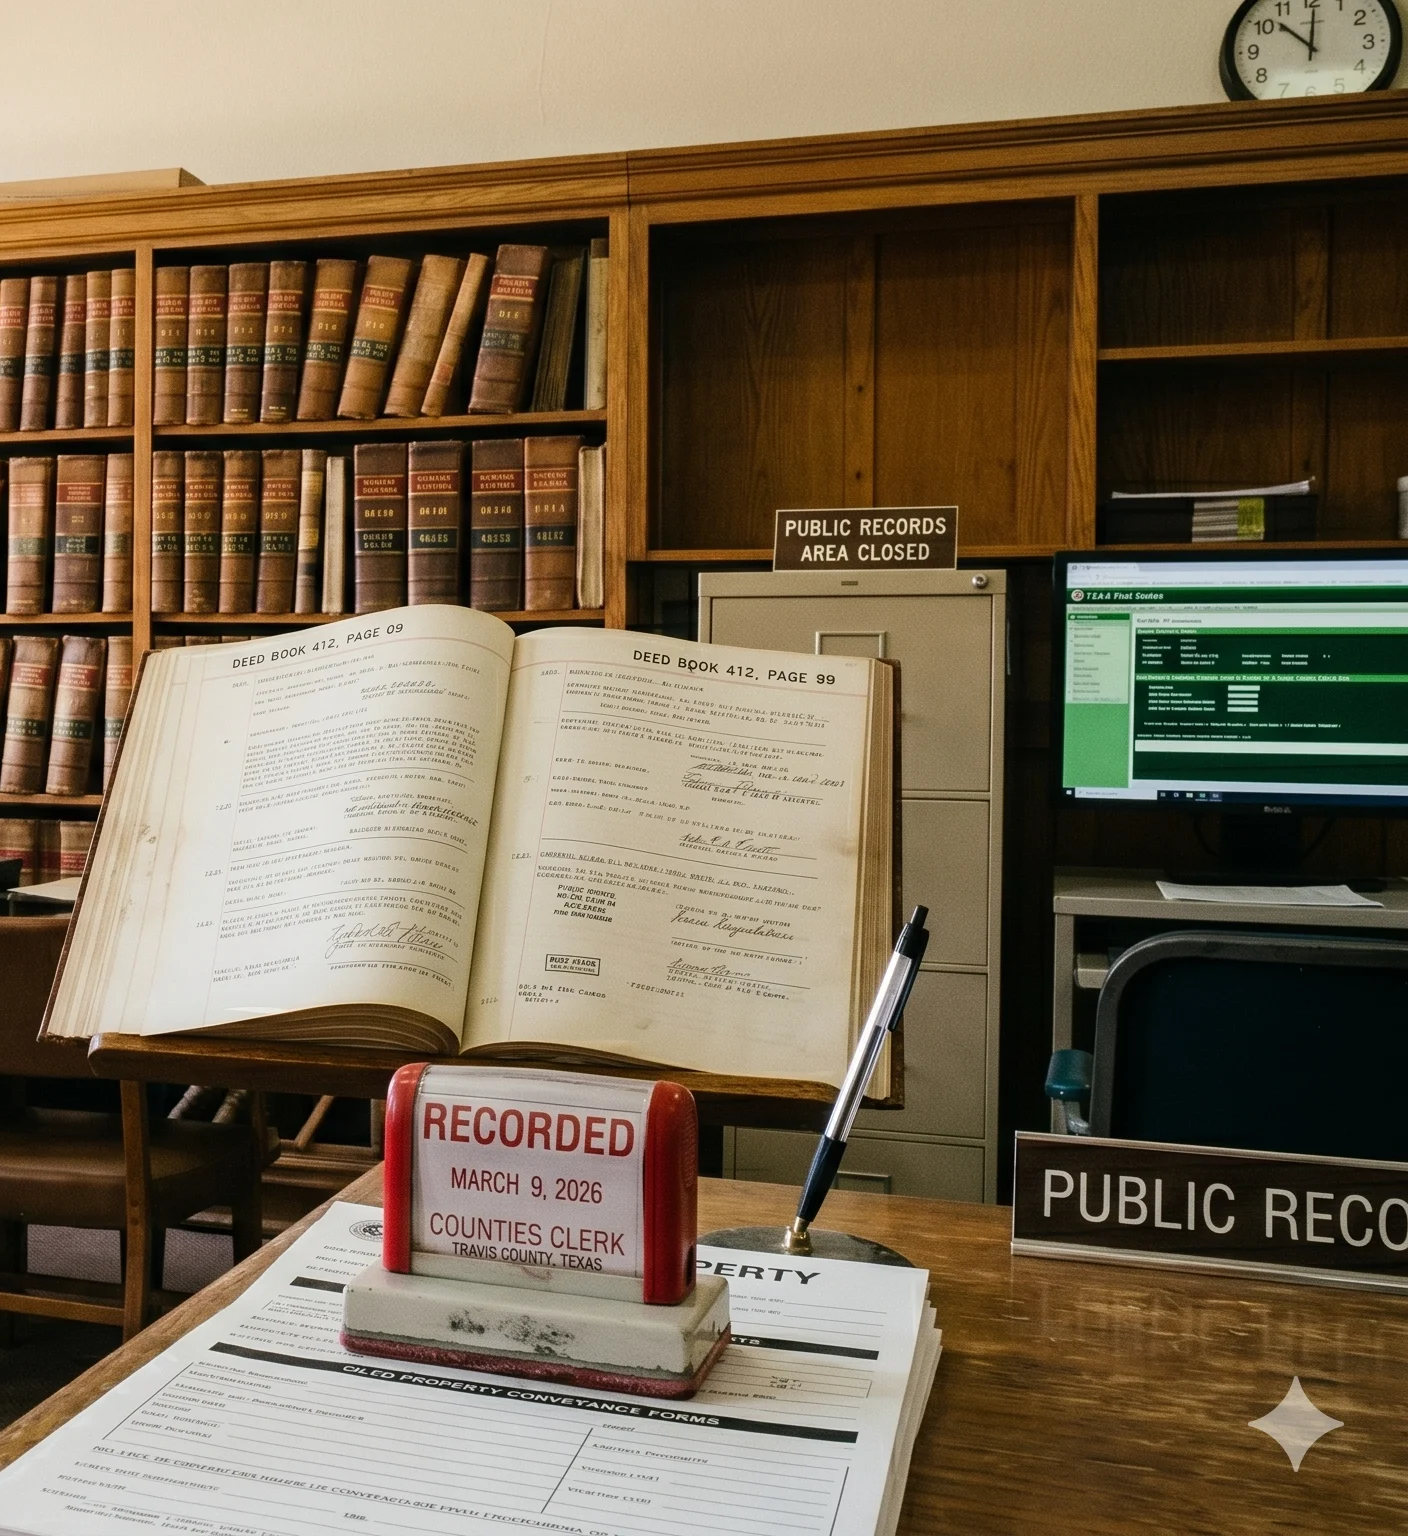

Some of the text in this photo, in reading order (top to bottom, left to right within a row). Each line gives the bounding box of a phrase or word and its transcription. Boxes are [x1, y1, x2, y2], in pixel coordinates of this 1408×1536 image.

[1275, 1, 1290, 16] 11
[1354, 10, 1366, 26] 2
[1254, 19, 1274, 35] 10
[1363, 34, 1375, 49] 3
[1248, 44, 1259, 60] 9
[1256, 68, 1267, 83] 8
[1354, 59, 1366, 74] 4
[1278, 83, 1289, 98] 7
[1334, 78, 1345, 93] 5
[785, 517, 947, 537] PUBLIC RECORDS
[800, 543, 930, 562] AREA CLOSED
[232, 623, 404, 668] DEED BOOK 412, PAGE 09
[633, 650, 836, 685] DEED BOOK 412, PAGE 99
[423, 1102, 635, 1157] RECORDED
[450, 1167, 603, 1204] MARCH 9, 2026
[1043, 1168, 1408, 1251] PUBLIC RECO
[430, 1212, 625, 1256] COUNTIES CLERK
[452, 1242, 497, 1260] TRAVIS
[560, 1253, 603, 1271] TEXAS
[343, 1365, 721, 1425] CILED PROPERTY CONVEYANCE FORMS
